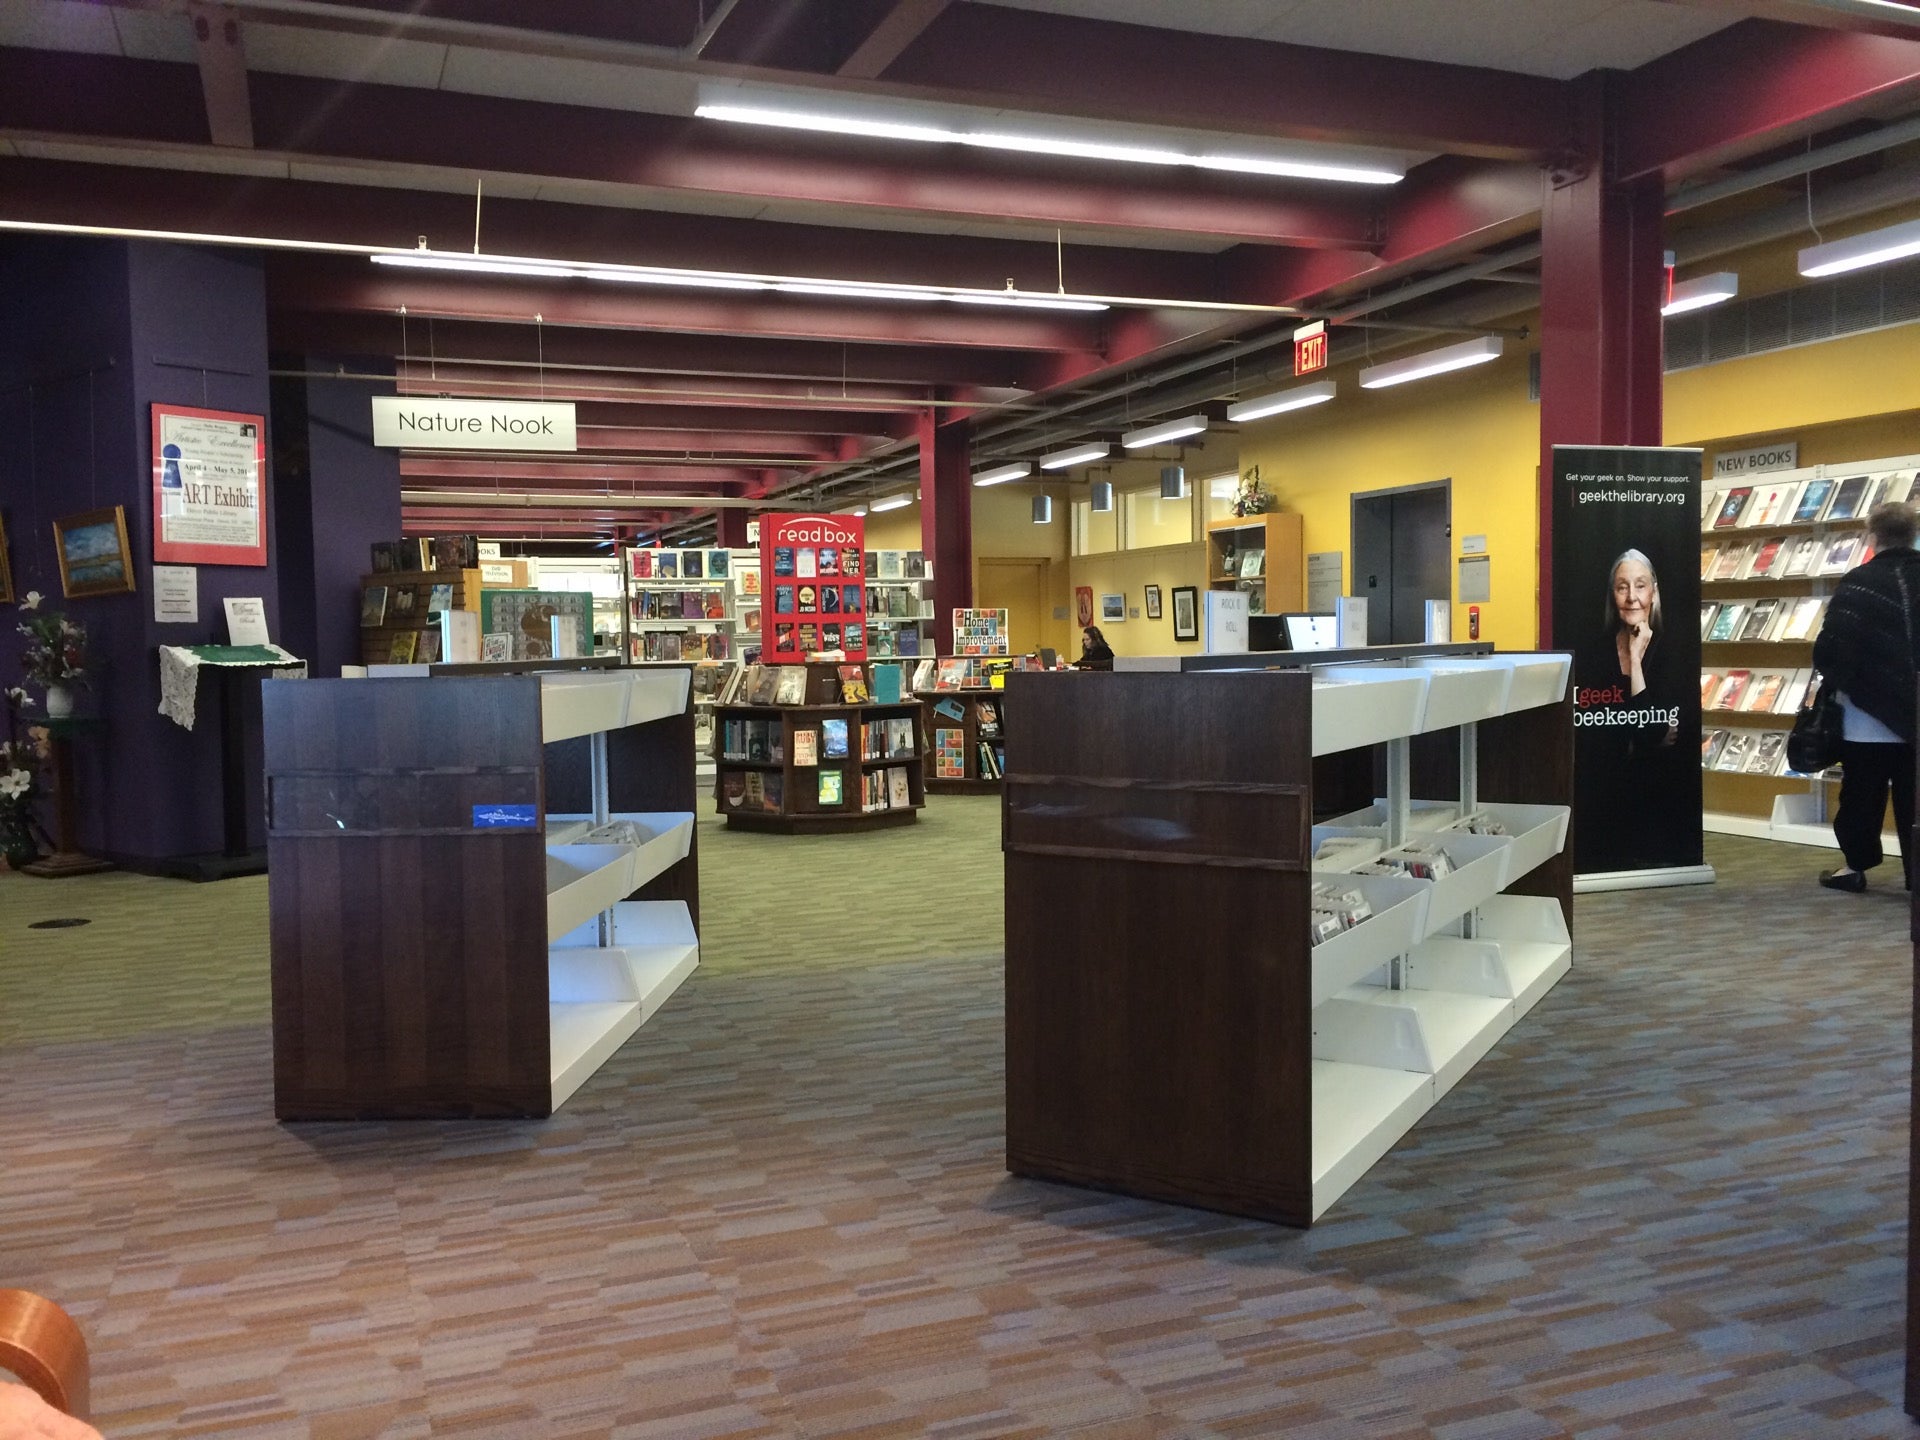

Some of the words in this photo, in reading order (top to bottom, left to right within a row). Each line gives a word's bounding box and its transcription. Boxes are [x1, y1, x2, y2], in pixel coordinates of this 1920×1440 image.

[1302, 336, 1323, 371] EXIT
[398, 412, 482, 433] Nature
[491, 415, 554, 435] Nook
[184, 463, 202, 472] April
[214, 465, 228, 474] May
[1717, 457, 1745, 472] NEW
[1749, 450, 1792, 467] BOOKS
[1565, 473, 1579, 481] Get
[1580, 474, 1596, 482] your
[1597, 474, 1614, 483] geek
[1627, 474, 1645, 482] Show
[1663, 475, 1691, 484] support.
[183, 482, 211, 505] ART
[214, 485, 254, 508] Exhibit
[1579, 489, 1686, 505] geekthelibrary.org
[963, 611, 989, 627] Home
[955, 629, 1007, 646] Improvement
[1579, 685, 1625, 708] geek
[1573, 706, 1680, 728] beekeeping
